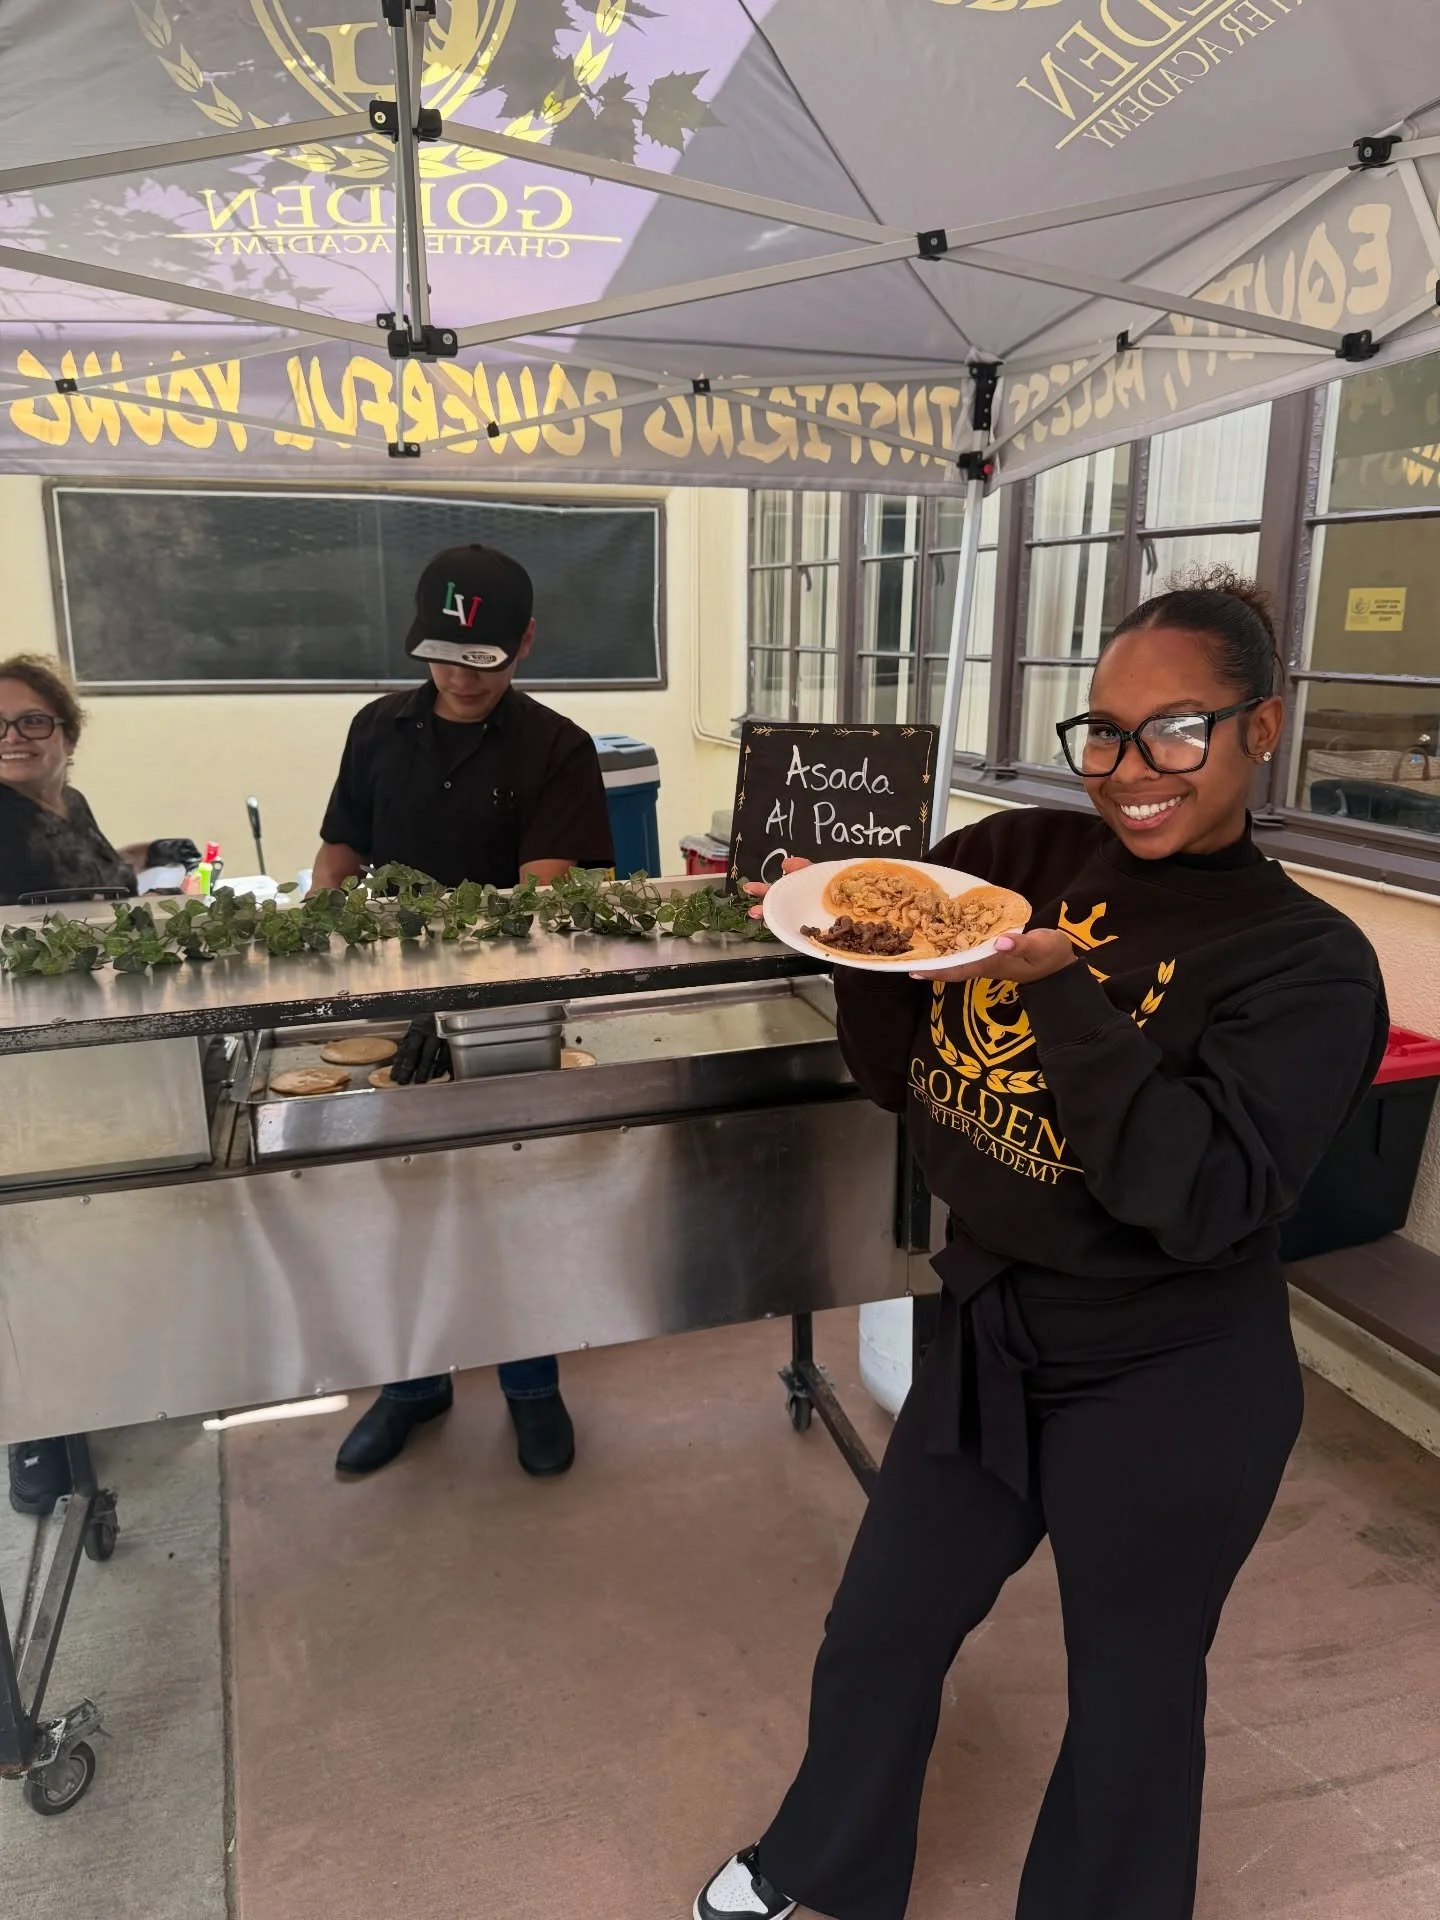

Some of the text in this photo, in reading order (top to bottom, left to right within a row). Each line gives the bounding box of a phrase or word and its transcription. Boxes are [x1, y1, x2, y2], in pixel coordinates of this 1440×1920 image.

[785, 744, 894, 795] Asada
[765, 798, 911, 847] Al Pastor
[910, 1057, 1067, 1161] GOLDEN
[913, 1089, 1065, 1185] CRTER ACADEMY
